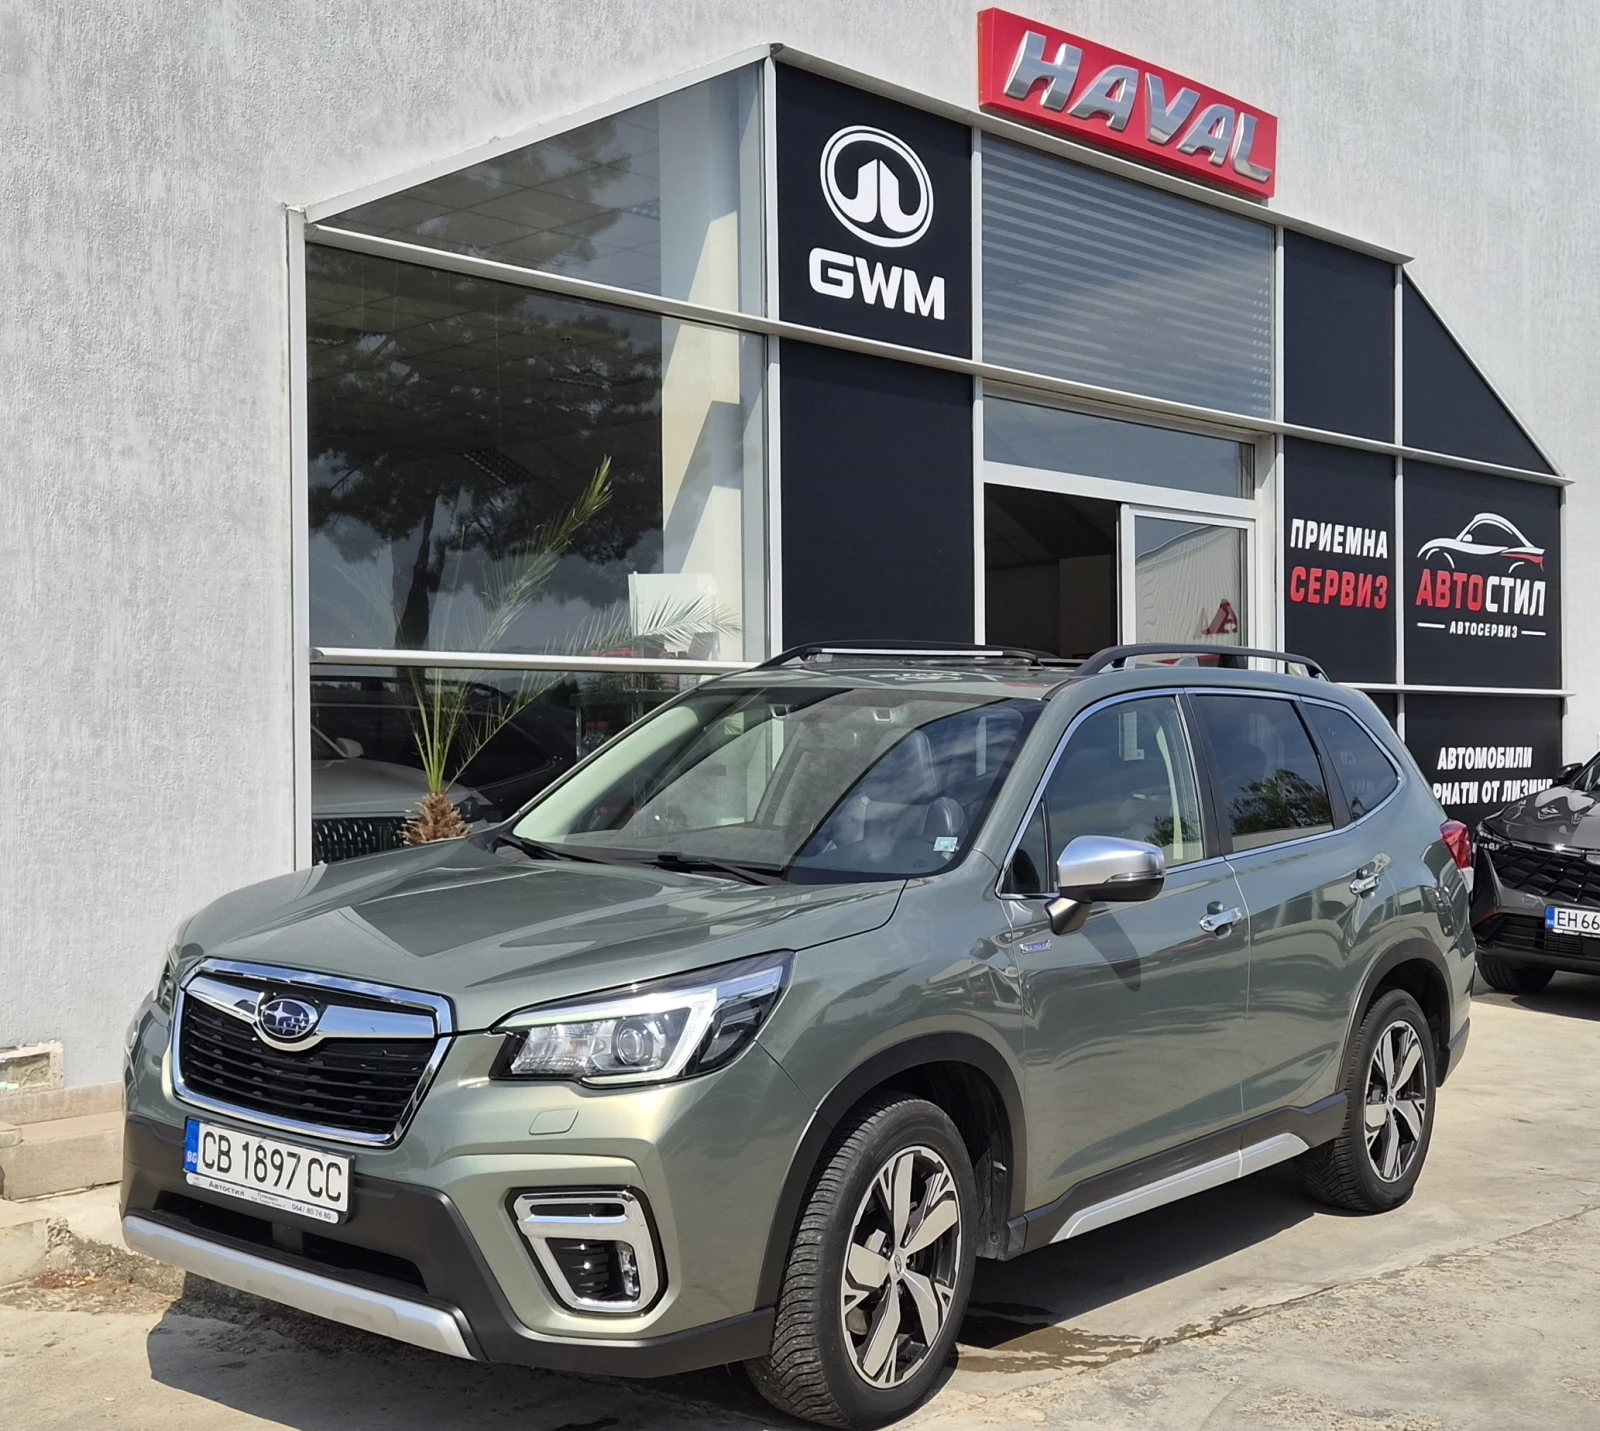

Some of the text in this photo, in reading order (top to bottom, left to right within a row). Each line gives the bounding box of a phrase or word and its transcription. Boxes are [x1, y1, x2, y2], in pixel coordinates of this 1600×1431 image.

[1003, 30, 1272, 183] HAVAL
[809, 248, 945, 320] GWM
[1290, 518, 1388, 559] ПРИЕМНА
[1290, 565, 1388, 610] СЕРВИЗ
[1415, 568, 1546, 616] АВТОСТИЛ
[1449, 620, 1518, 639] АВТОСЕРВИЗ
[1436, 746, 1533, 770] АВТОМОБИЛИ
[1432, 781, 1479, 805] РНАТИ
[1481, 780, 1500, 804] ОТ
[1557, 910, 1600, 931] EH 66
[187, 1150, 198, 1164] BG
[202, 1131, 342, 1202] CB 1897 CC
[208, 1180, 245, 1197] Автостил
